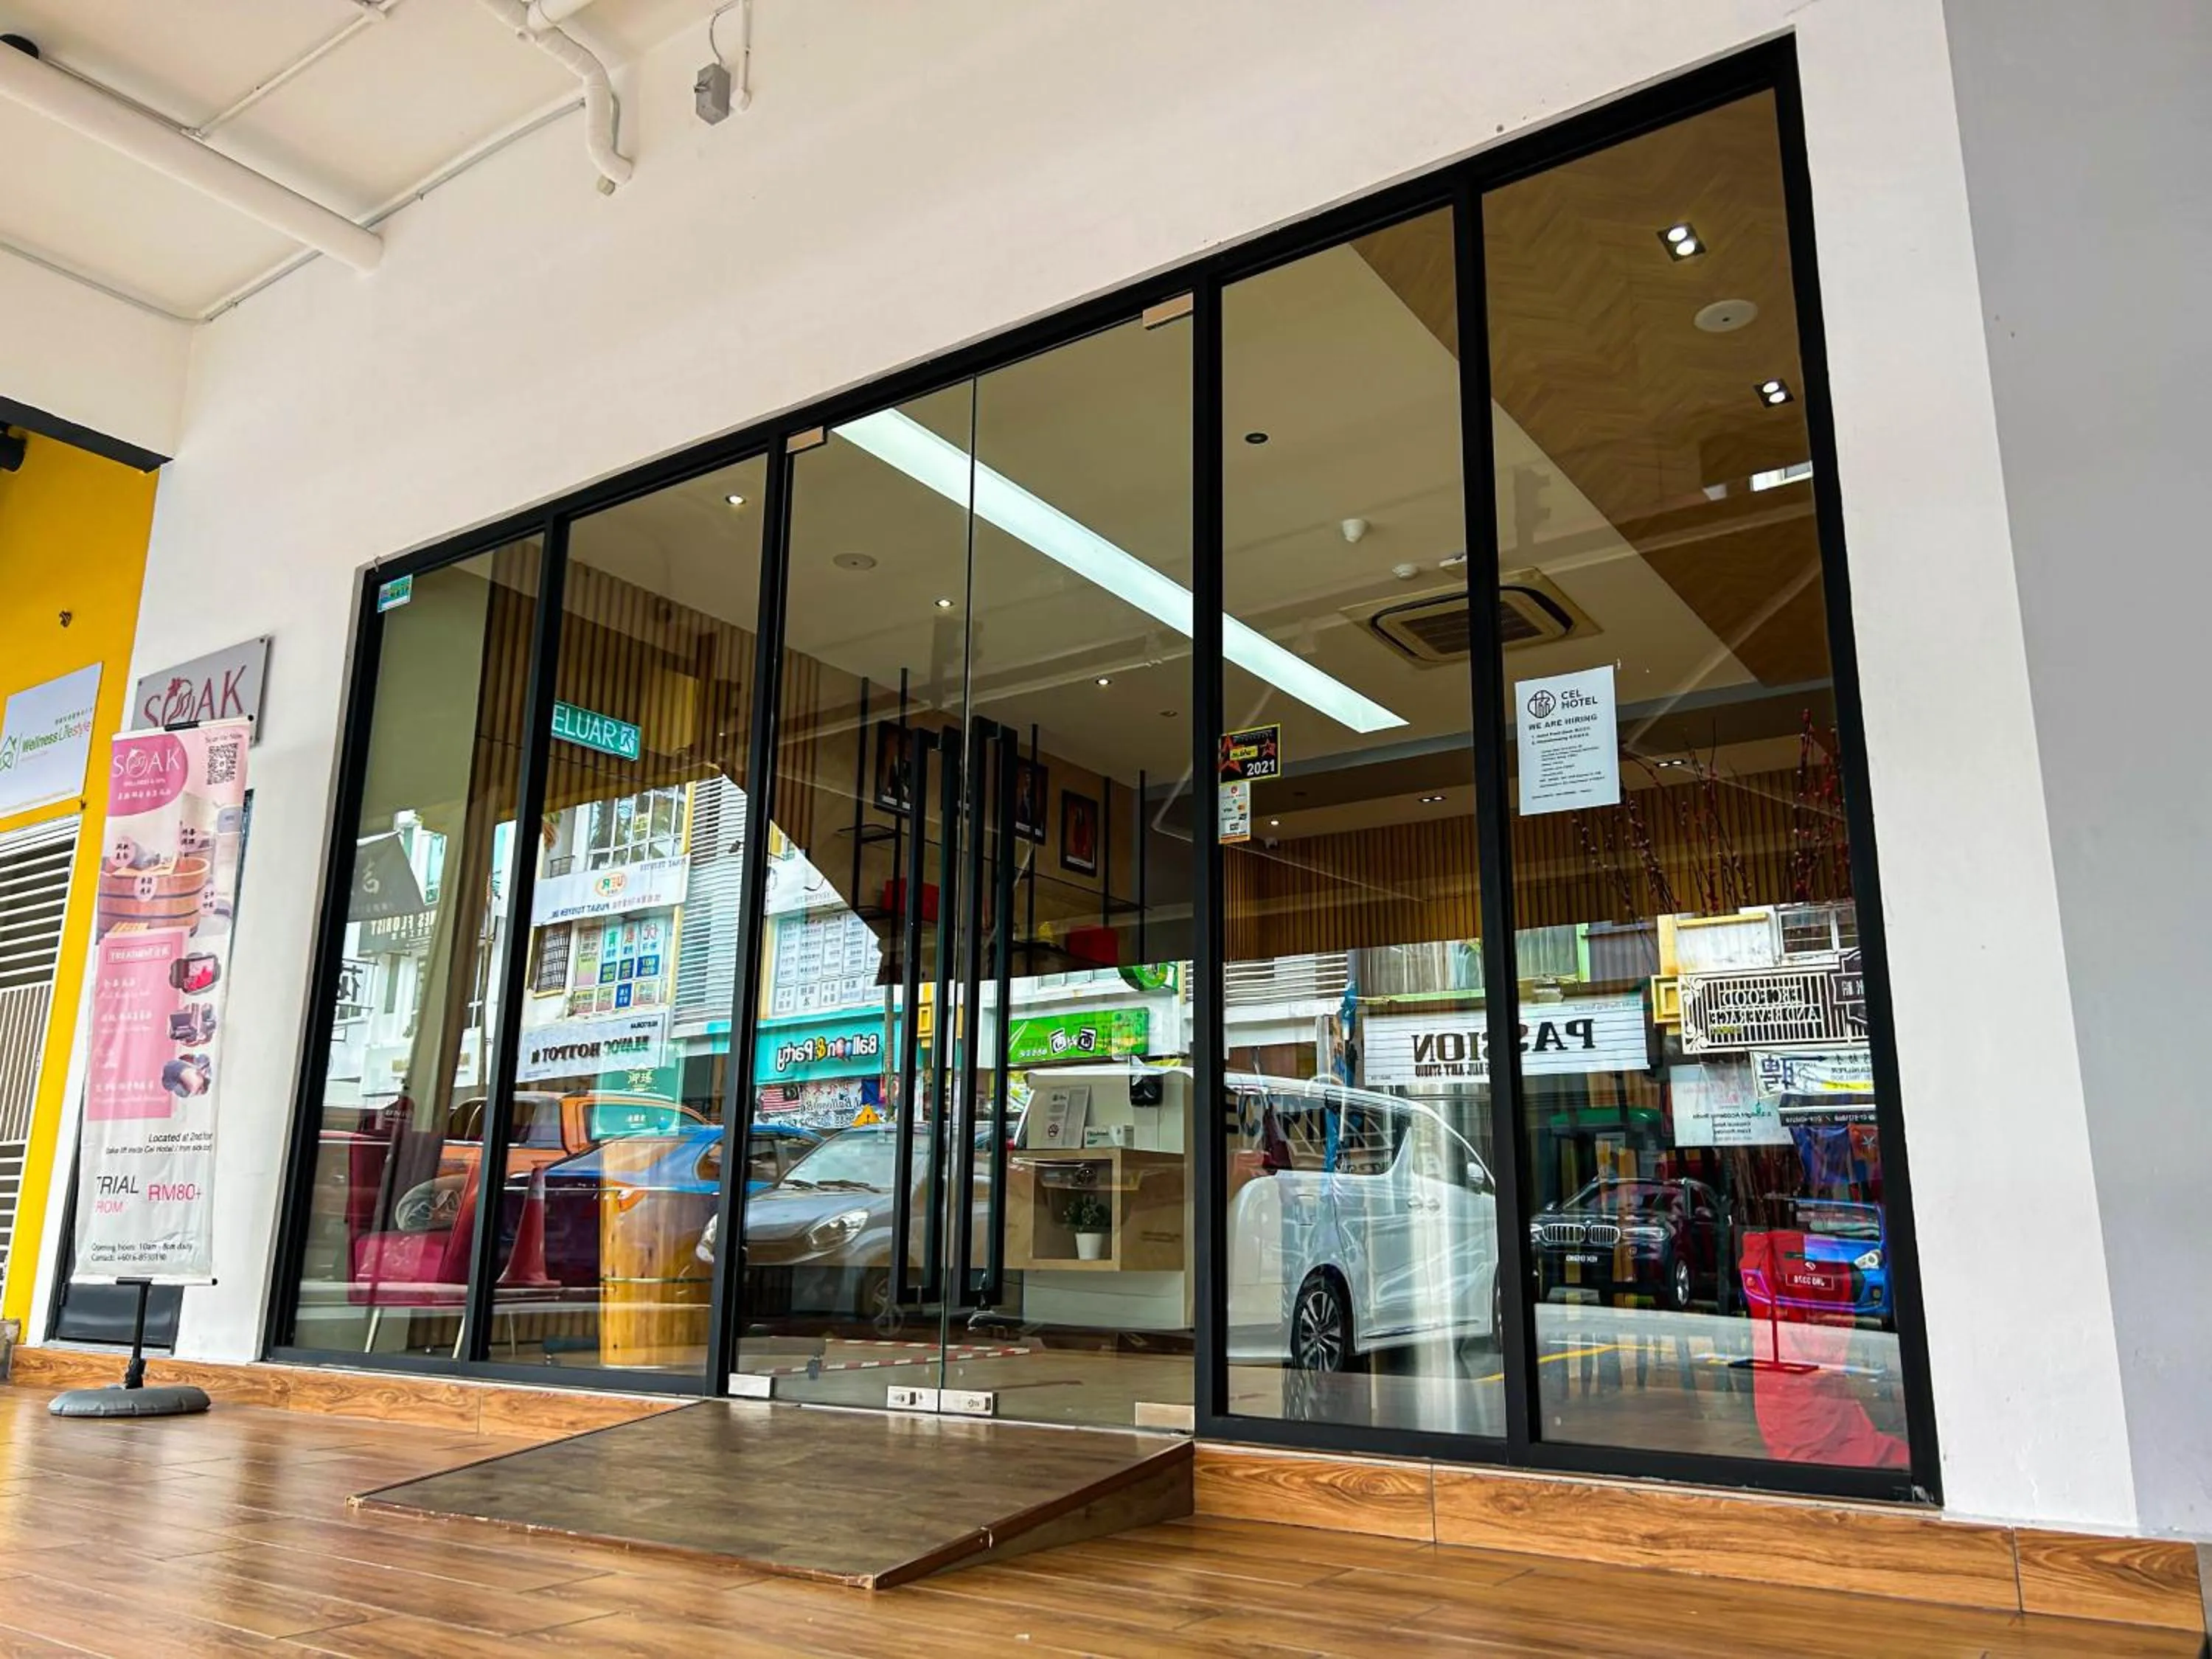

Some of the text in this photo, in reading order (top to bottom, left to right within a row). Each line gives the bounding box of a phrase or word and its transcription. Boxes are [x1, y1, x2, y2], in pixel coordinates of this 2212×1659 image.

[1561, 689, 1582, 700] CEL
[1561, 696, 1598, 709] HOTEL
[1545, 720, 1562, 728] ARE
[1565, 714, 1598, 725] HIRING
[112, 747, 181, 779] SOAK
[1247, 759, 1275, 776] 2021
[149, 1133, 181, 1142] Located
